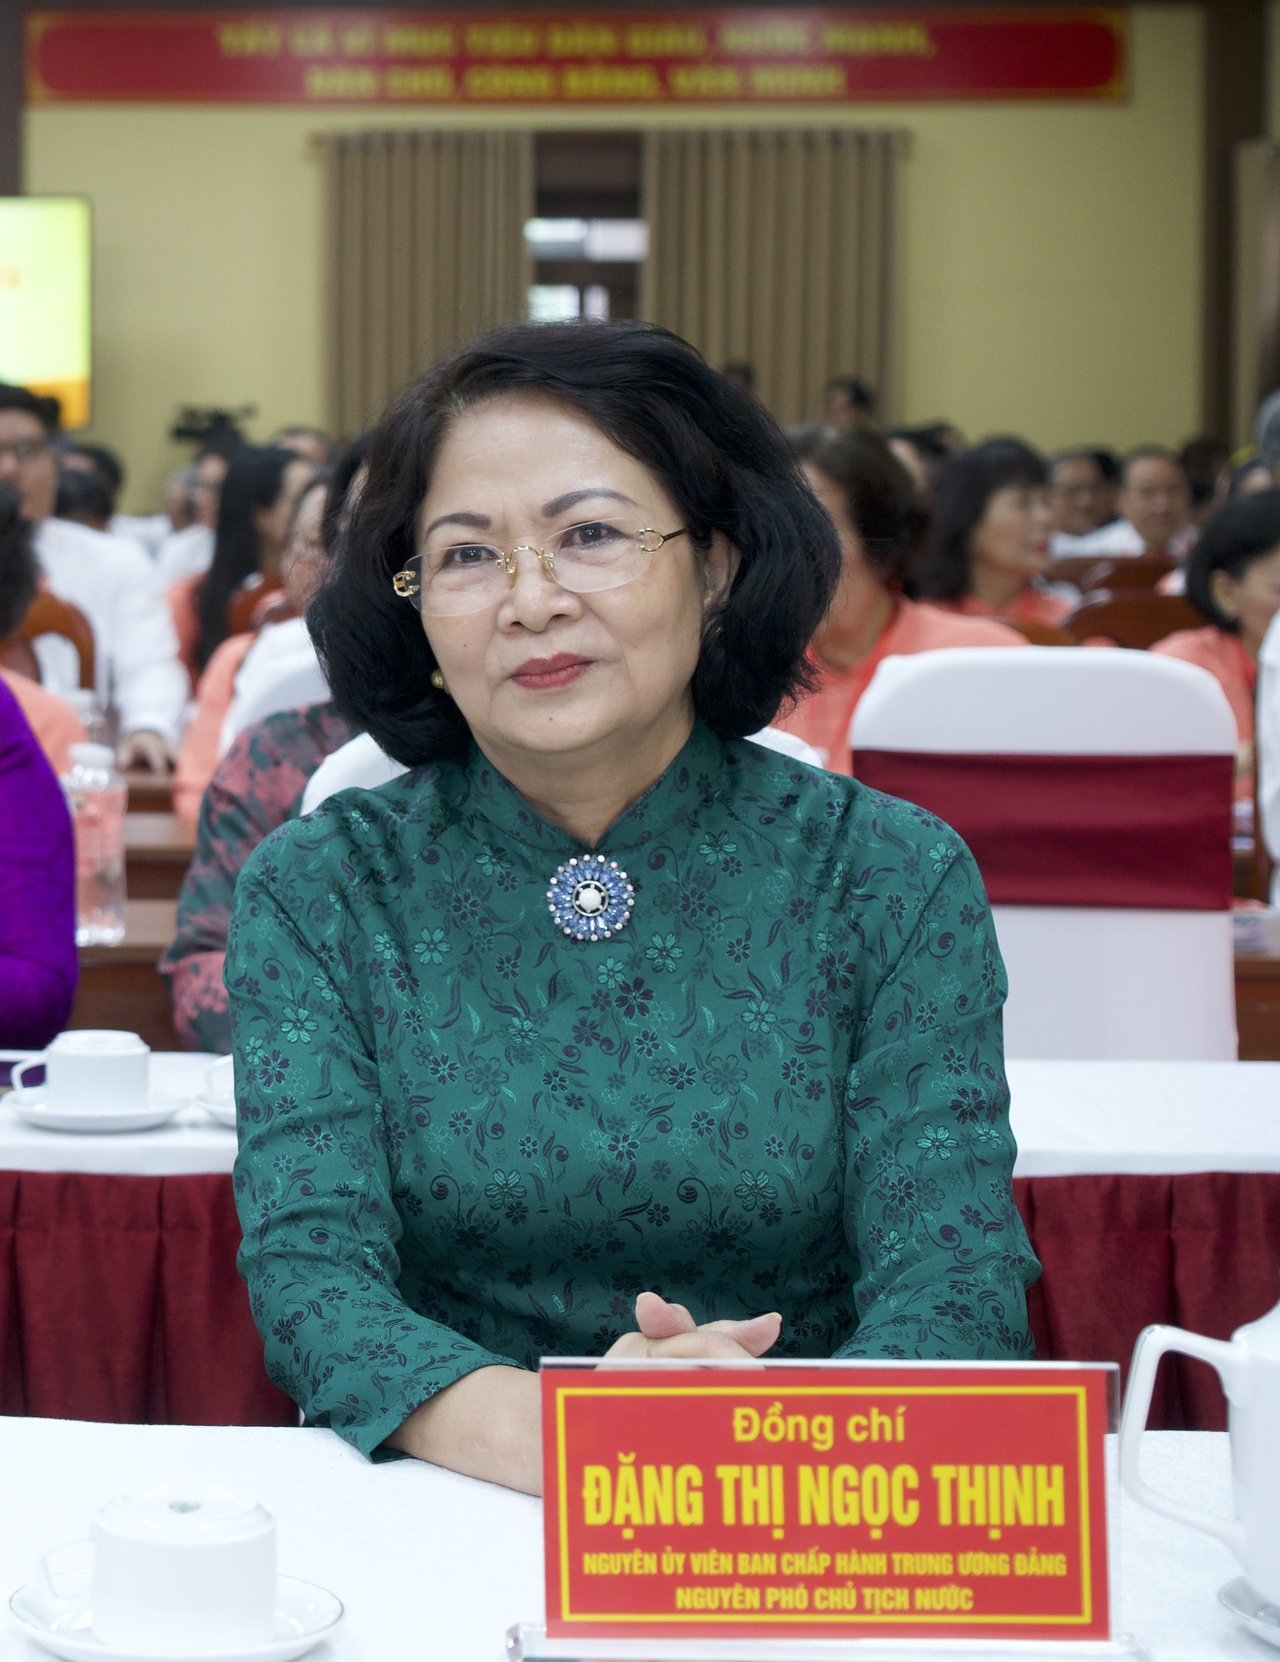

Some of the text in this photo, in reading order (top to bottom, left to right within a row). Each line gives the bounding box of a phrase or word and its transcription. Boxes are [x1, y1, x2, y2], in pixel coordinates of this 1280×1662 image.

[733, 1401, 906, 1451] Đồng chí
[582, 1453, 1065, 1540] ĐẶNG THỊ NGỌC THỊNH
[582, 1545, 1068, 1577] NGUYÊN ỦY VIÊN BAN CHẤP HÀNH TRUNG ƯƠNG ĐẢNG
[675, 1581, 974, 1614] NGUYÊN PHÓ CHỦ TỊCH NƯỚC
